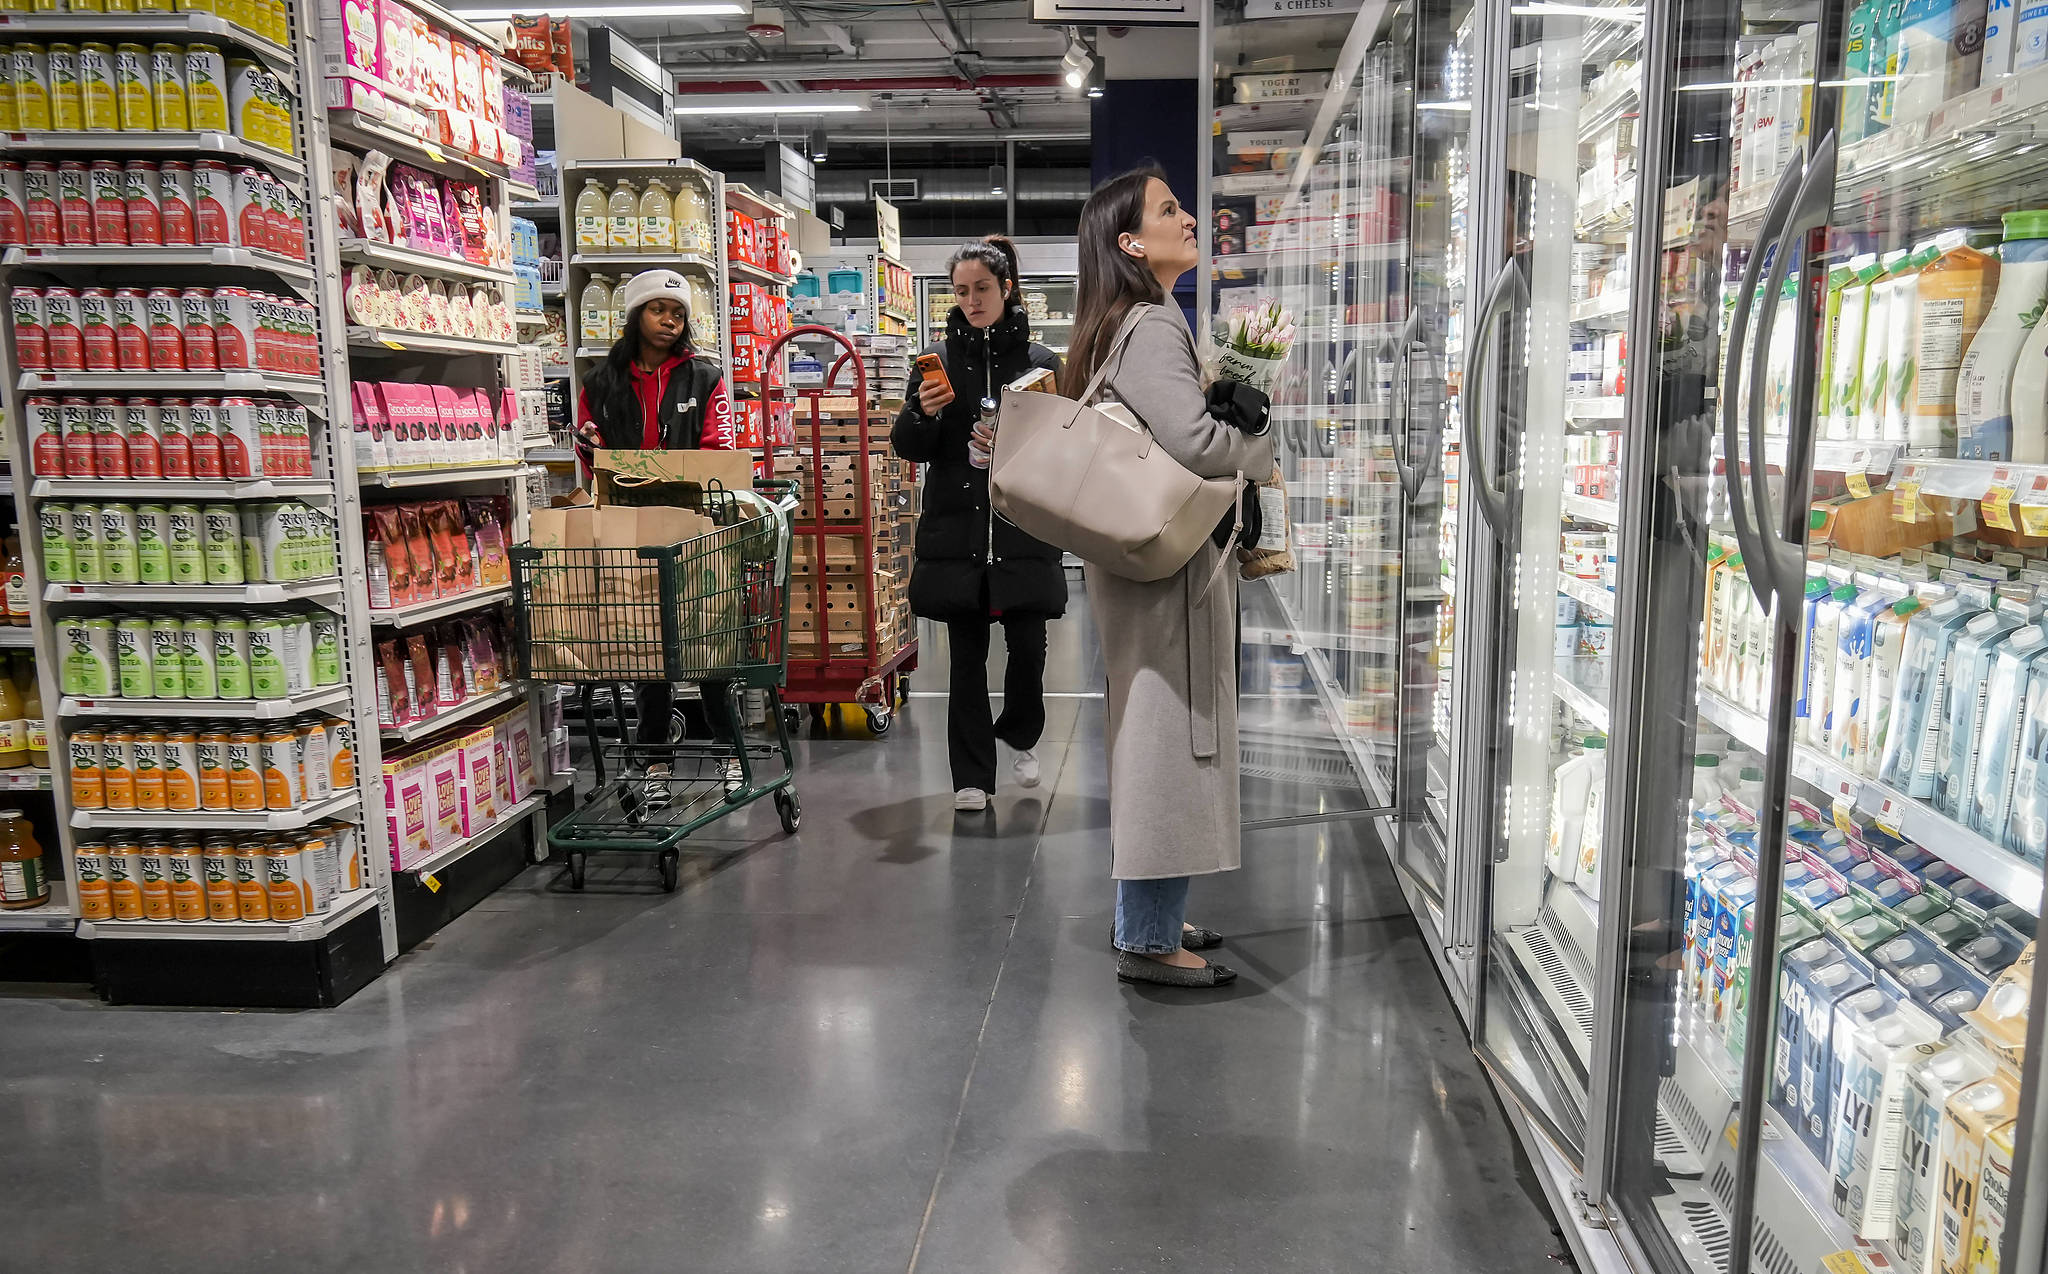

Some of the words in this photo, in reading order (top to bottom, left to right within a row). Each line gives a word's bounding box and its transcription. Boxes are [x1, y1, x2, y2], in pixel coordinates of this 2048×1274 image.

[1274, 2, 1283, 11] &
[1287, 0, 1334, 10] CHEESE
[517, 36, 546, 54] plits
[1260, 78, 1301, 87] YOGURT
[1271, 88, 1301, 97] KEFIR
[1249, 138, 1284, 147] YOGURT
[93, 172, 121, 189] Ryl
[12, 298, 37, 314] Ryl
[47, 298, 71, 314] Ryl
[81, 298, 105, 314] Ryl
[184, 299, 207, 314] Ryl
[730, 306, 750, 317] ORN
[38, 407, 60, 423] Ry
[65, 407, 91, 424] Ryl
[714, 391, 734, 450] TOMMY
[102, 514, 126, 530] Ryl
[170, 514, 194, 531] Ryl
[206, 515, 232, 531] Ryl
[153, 630, 177, 647] Ryl
[72, 743, 95, 759] Ryl
[133, 744, 156, 760] Ryl
[474, 767, 489, 781] LOVE
[438, 780, 455, 799] LOVE
[405, 795, 422, 812] LOVE
[440, 796, 456, 812] CORN
[77, 857, 101, 872] Ryl
[266, 858, 288, 873] Ryl
[1843, 1088, 1873, 1137] LY!
[1902, 1124, 1931, 1177] LY!
[1943, 1160, 1972, 1217] LY!
